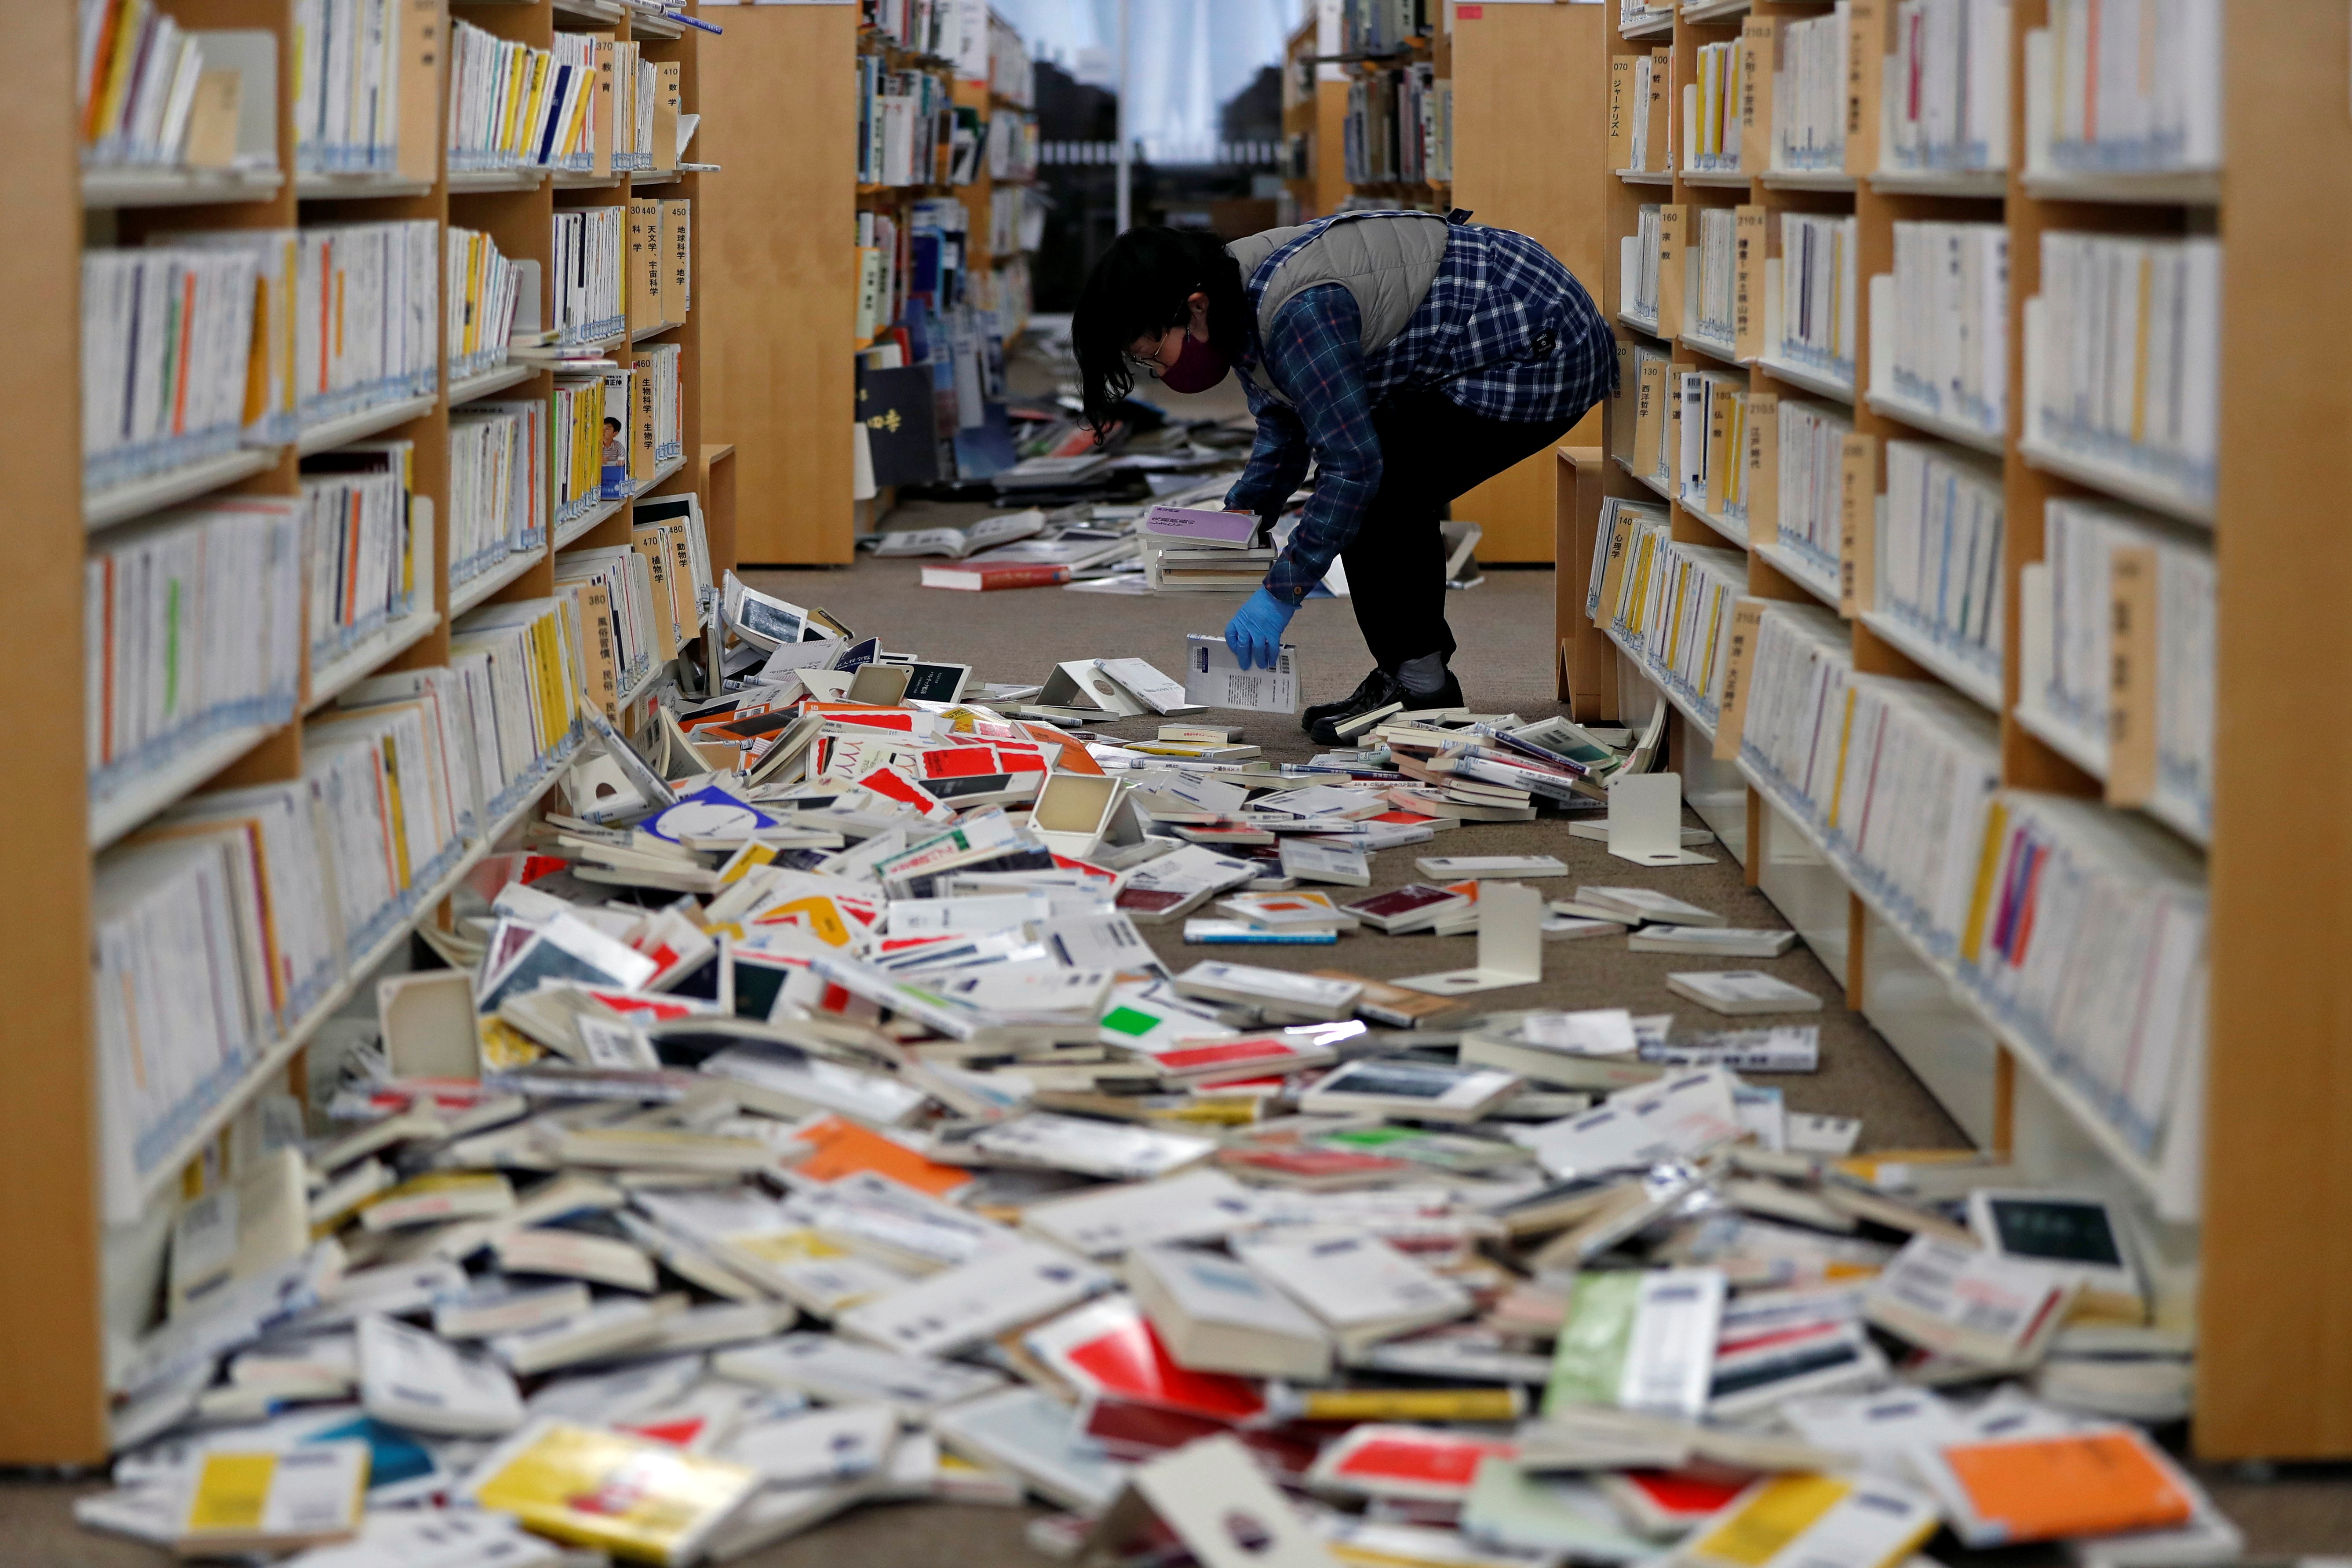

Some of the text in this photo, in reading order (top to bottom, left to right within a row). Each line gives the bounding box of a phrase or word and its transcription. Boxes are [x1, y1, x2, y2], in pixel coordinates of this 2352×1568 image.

[602, 62, 612, 93] 教育
[1651, 74, 1661, 101] 哲学
[668, 84, 678, 106] 数学
[1611, 80, 1621, 137] ジャーナリズム
[631, 206, 640, 215] 30
[1663, 213, 1677, 222] 160
[676, 226, 686, 285] 地球科学、地学
[1661, 233, 1671, 260] 宗教
[647, 225, 659, 296] 天文学、宇宙科学
[642, 378, 653, 449] 生物科学、生物学
[1640, 385, 1651, 417] 西洋哲学
[669, 525, 683, 534] 480
[1619, 517, 1633, 525] 140
[643, 537, 658, 546] 470
[1611, 534, 1623, 559] 心理学
[676, 543, 688, 568] 動物学
[651, 555, 664, 583] 植物学
[588, 595, 606, 606] 380
